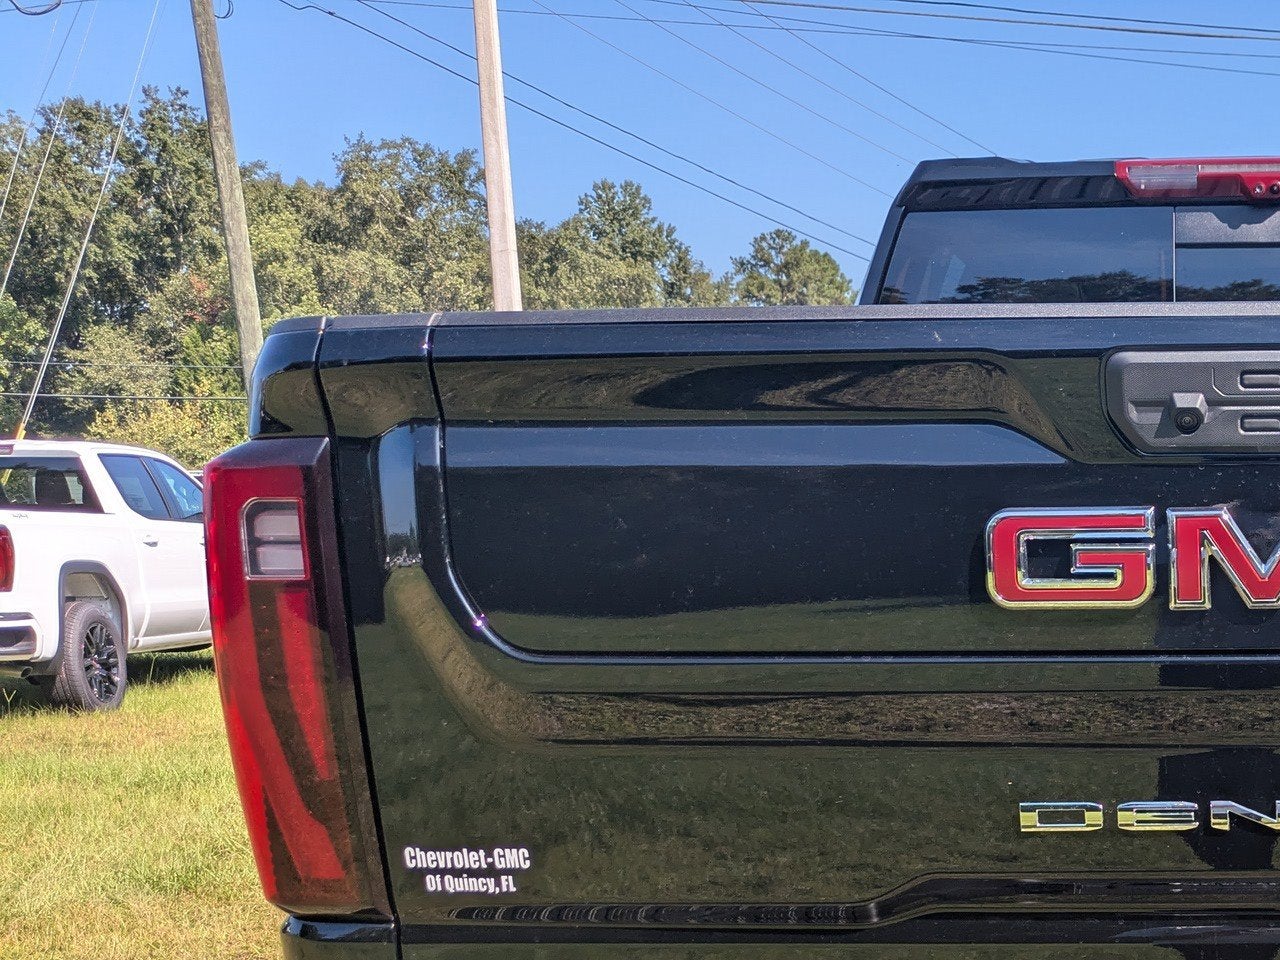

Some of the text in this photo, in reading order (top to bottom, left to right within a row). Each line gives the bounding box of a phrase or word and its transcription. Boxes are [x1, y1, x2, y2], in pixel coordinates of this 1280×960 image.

[404, 846, 531, 869] Chevrolet-GMC
[425, 874, 517, 894] Of Quincy, FL
